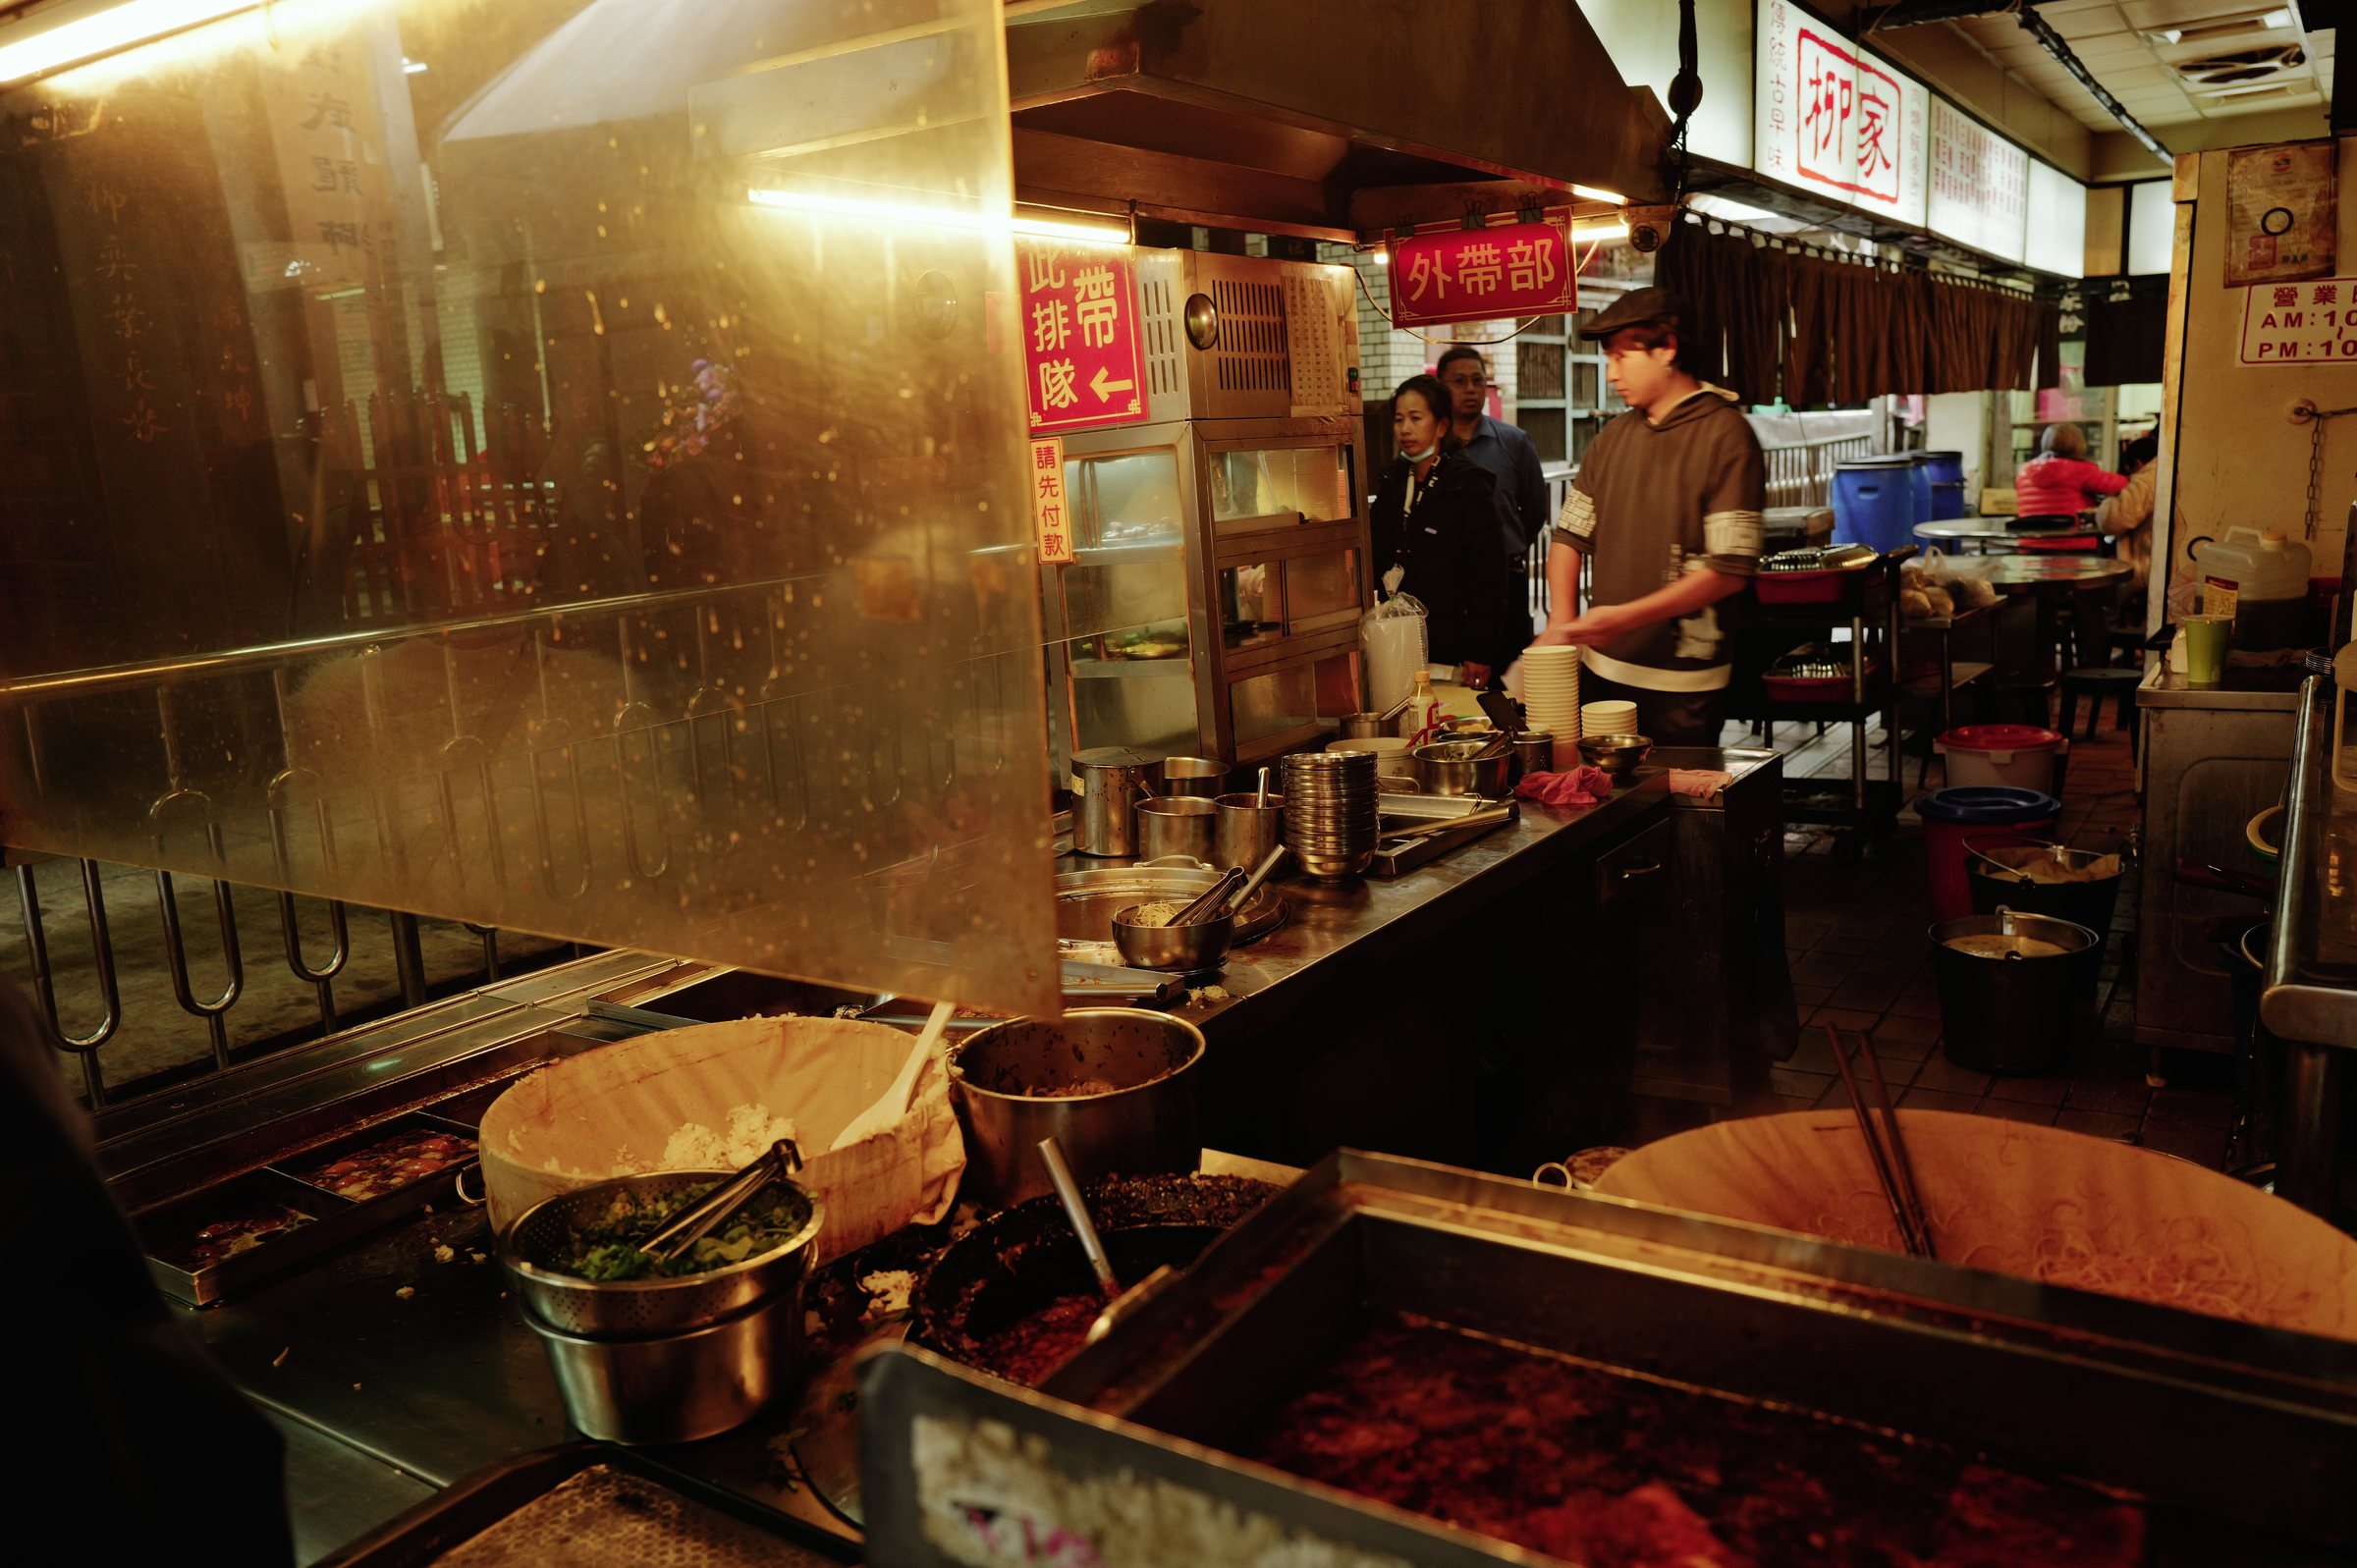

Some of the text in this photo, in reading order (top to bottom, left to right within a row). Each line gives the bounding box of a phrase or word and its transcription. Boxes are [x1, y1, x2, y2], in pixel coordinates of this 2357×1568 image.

[1805, 55, 1891, 179] 柳家
[1028, 245, 1078, 411] 此排隊
[1407, 238, 1556, 301] 外帶部
[1035, 445, 1065, 557] 請先付款
